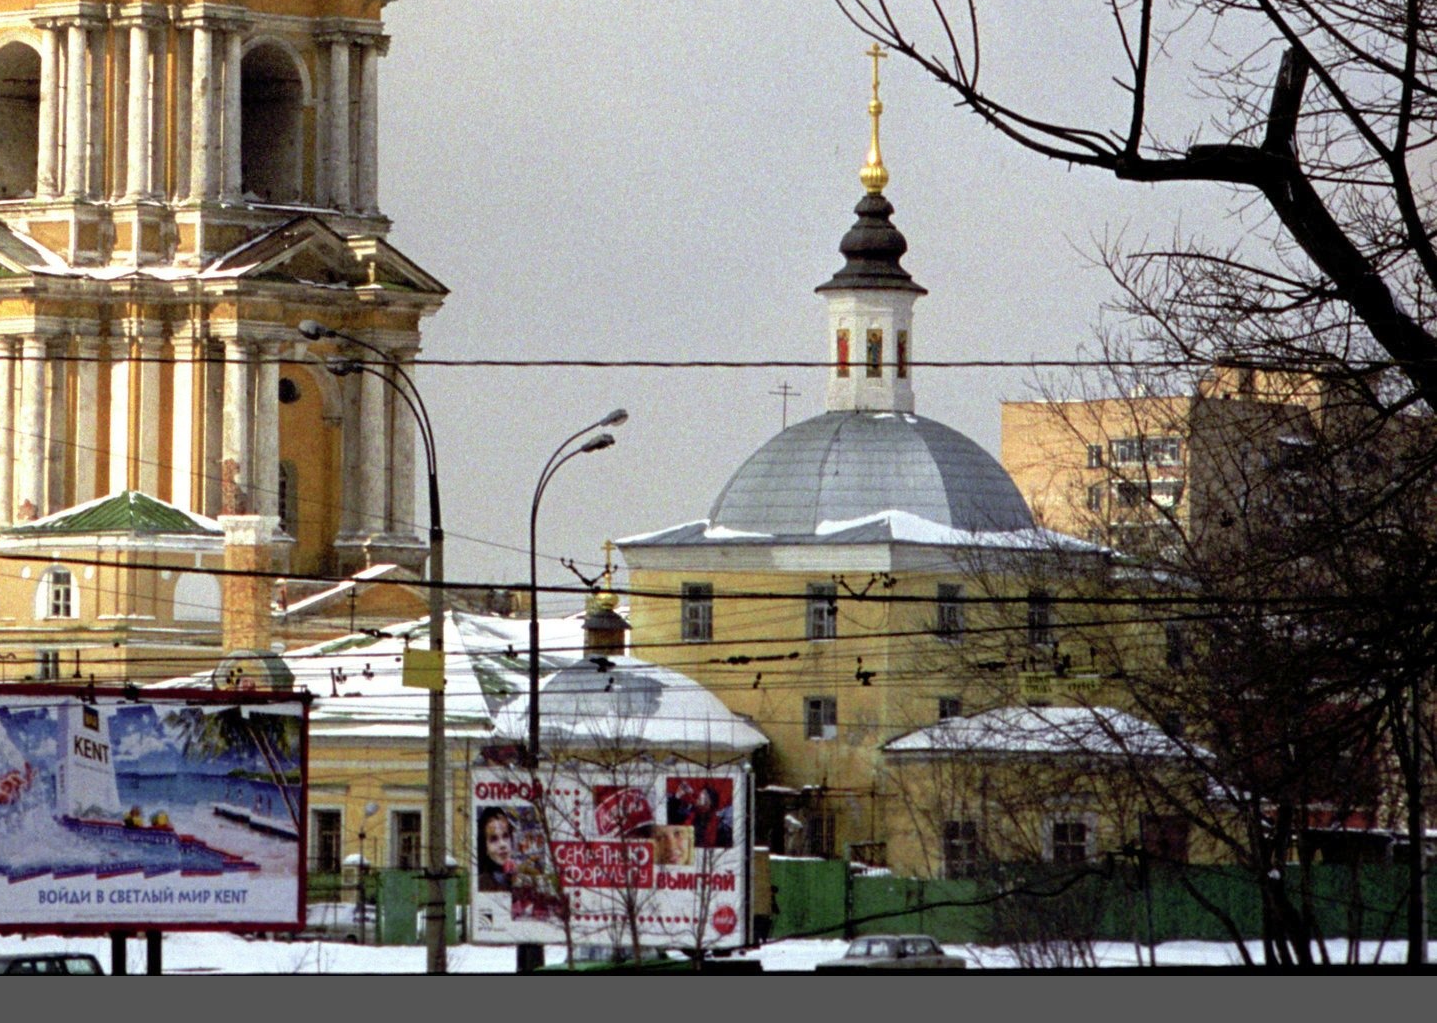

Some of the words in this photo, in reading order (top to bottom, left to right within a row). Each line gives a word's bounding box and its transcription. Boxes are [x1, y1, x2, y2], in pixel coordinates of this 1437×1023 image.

[74, 735, 109, 764] KENT
[657, 870, 735, 891] ВЫИГРАЙ
[38, 886, 91, 904] ВОЙДИ
[96, 889, 104, 904] В
[109, 886, 174, 904] СВЕТЛЫЙ
[178, 889, 211, 904] МИР
[214, 889, 248, 904] KENT
